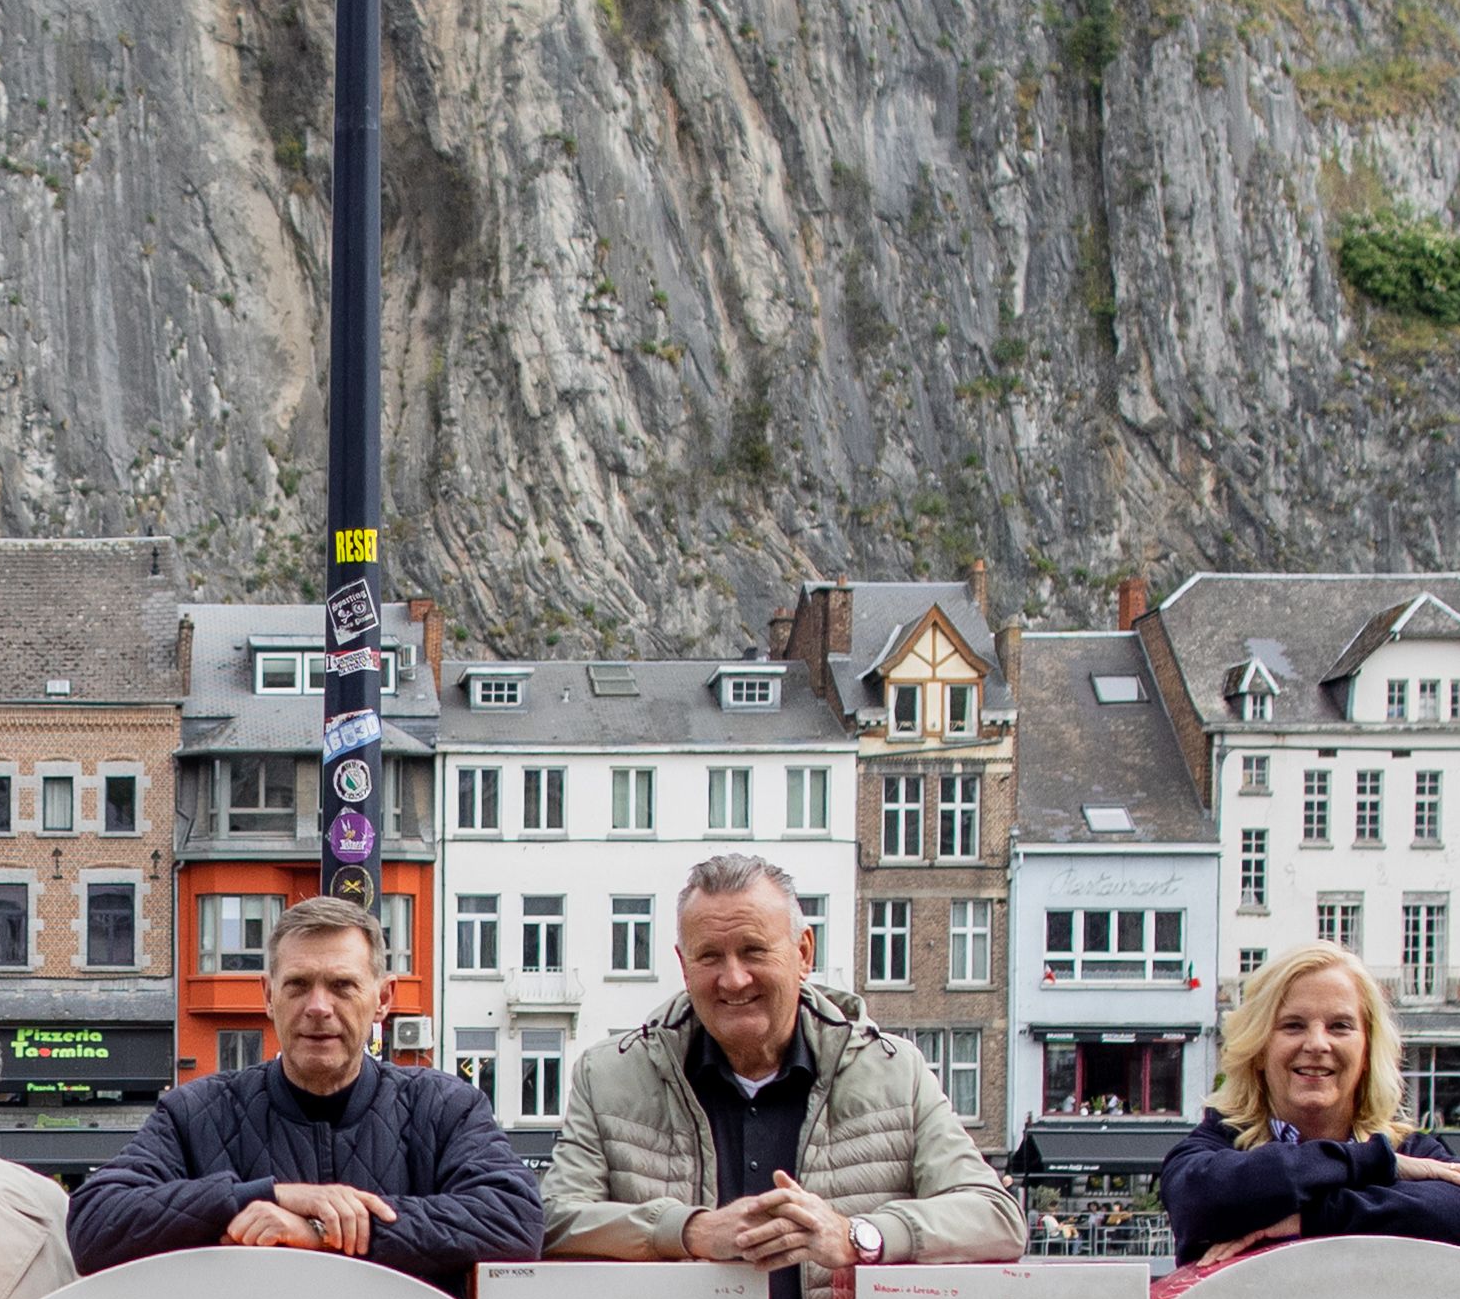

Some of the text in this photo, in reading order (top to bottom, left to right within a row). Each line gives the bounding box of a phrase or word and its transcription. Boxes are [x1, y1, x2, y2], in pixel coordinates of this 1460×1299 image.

[335, 529, 378, 564] RESET
[17, 1028, 103, 1042] Pizzeria
[10, 1040, 109, 1058] Taormina
